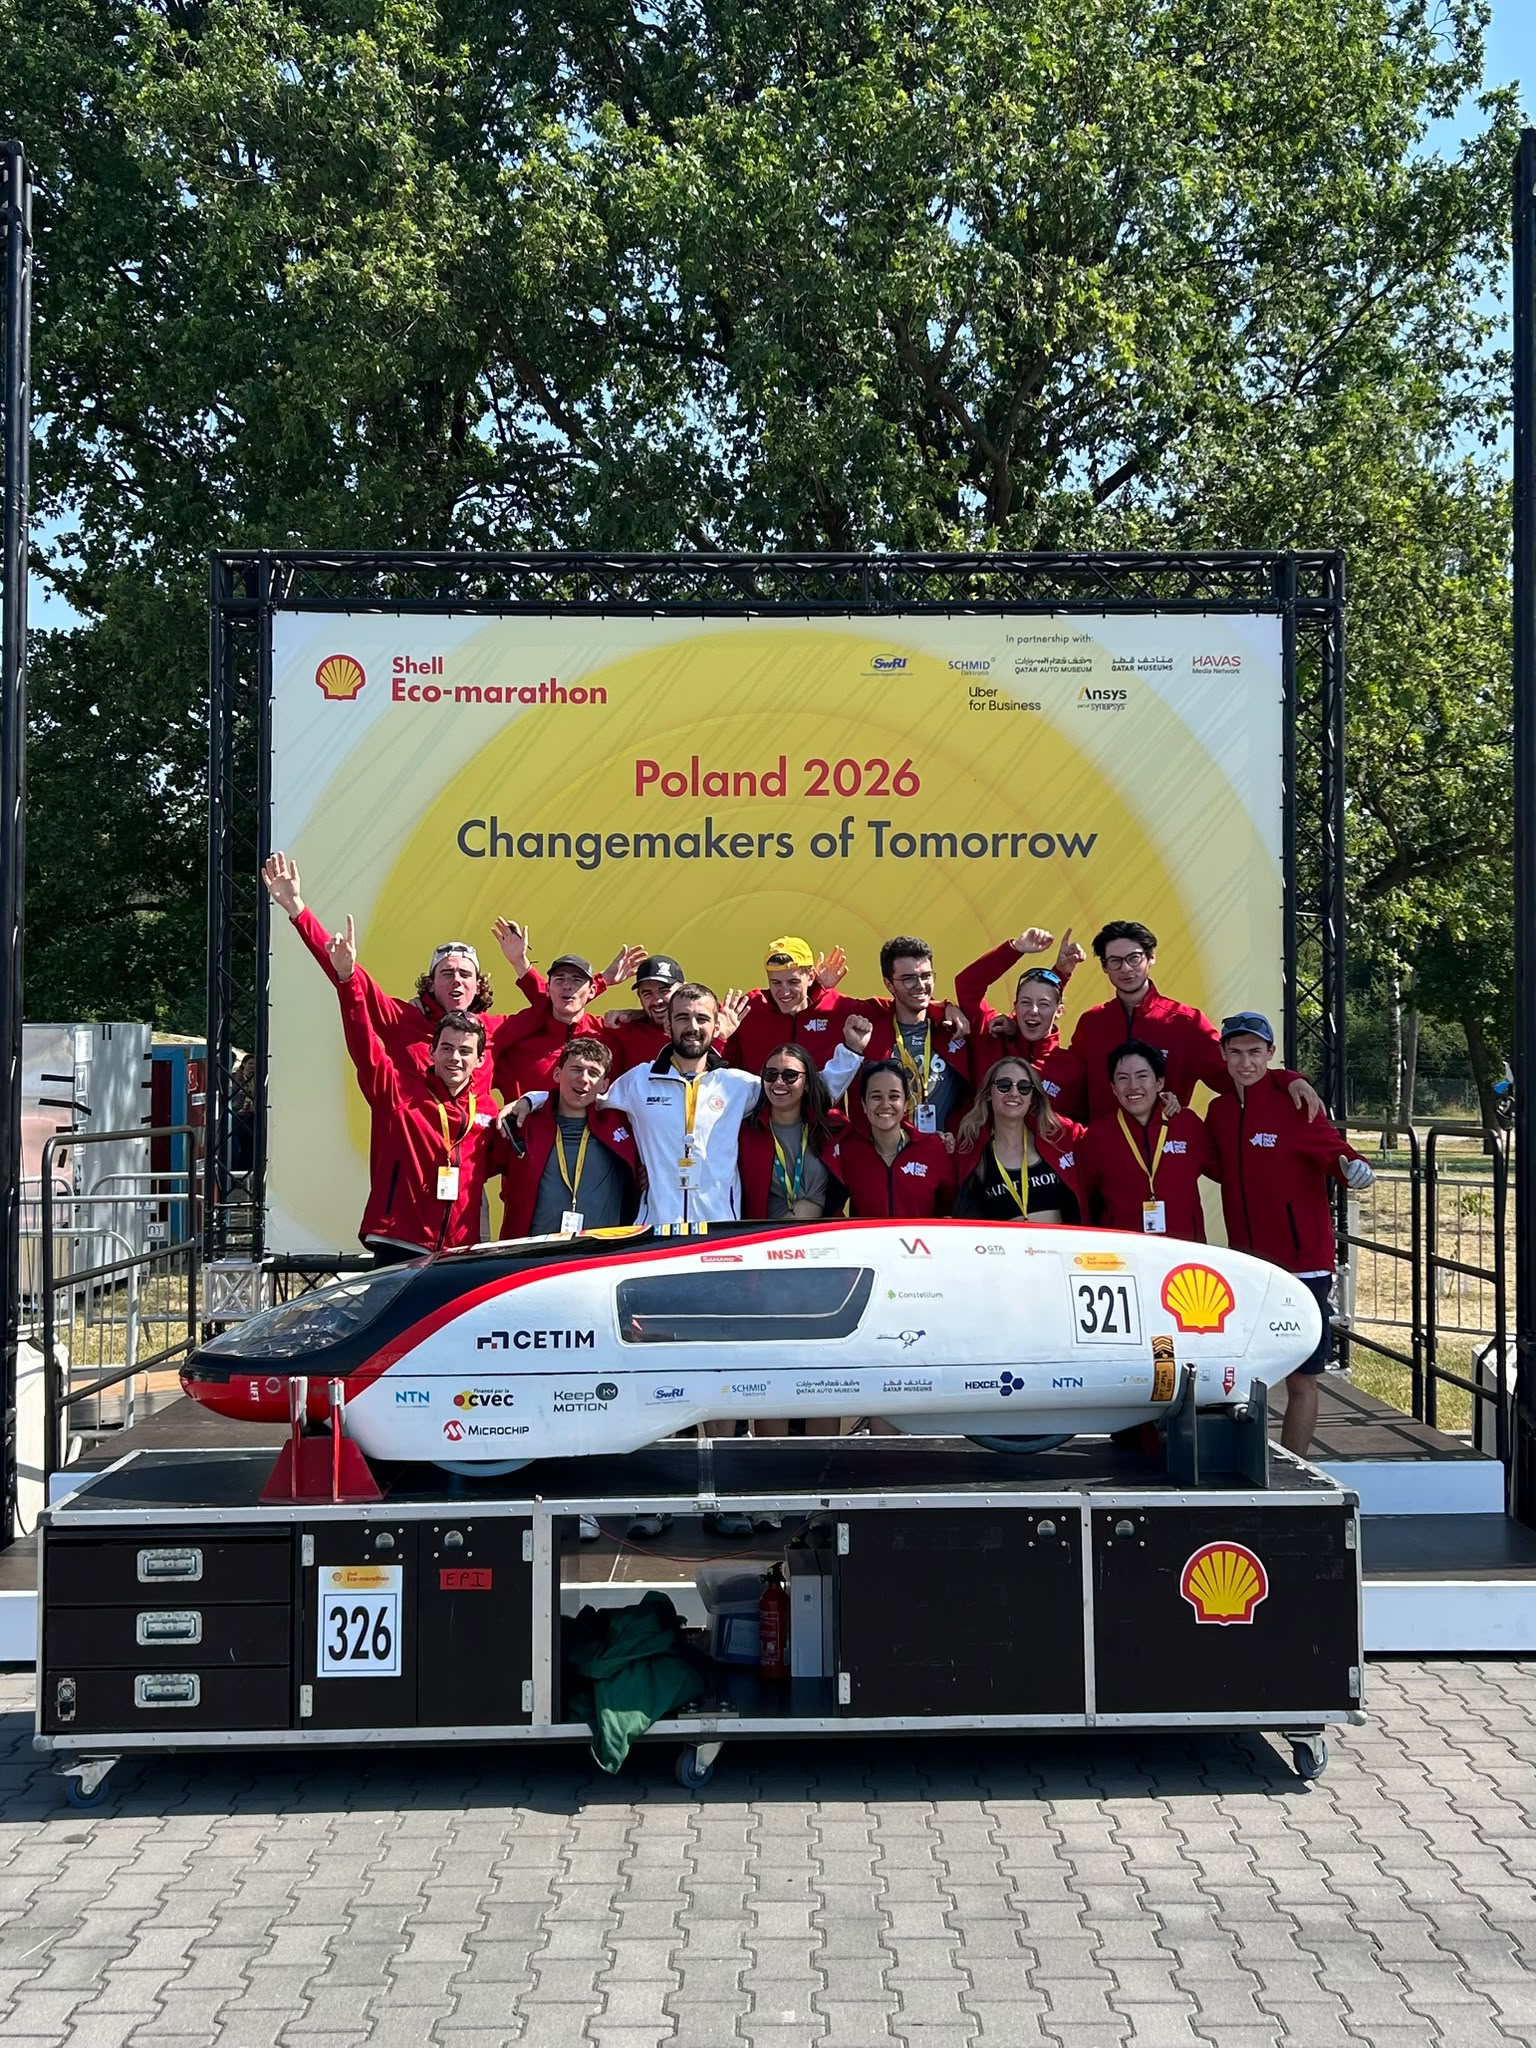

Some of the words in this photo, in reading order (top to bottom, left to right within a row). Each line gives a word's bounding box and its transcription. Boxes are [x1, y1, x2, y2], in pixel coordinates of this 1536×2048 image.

[1006, 634, 1014, 643] In
[1017, 633, 1070, 645] partnership
[1072, 634, 1094, 643] with:
[392, 656, 443, 675] Shell
[873, 658, 908, 669] SwRI
[948, 660, 991, 670] SCHMID
[1192, 655, 1241, 667] HAVAS
[1014, 666, 1038, 674] QATAR
[1137, 664, 1174, 672] MUSEUMS
[391, 678, 608, 705] Eco-marathon
[969, 687, 998, 697] Uber
[1077, 686, 1128, 700] Ansys
[969, 700, 986, 711] for
[989, 700, 1042, 711] Business
[635, 755, 787, 797] Poland
[803, 757, 922, 798] 2026
[457, 816, 797, 871] Changemakers
[810, 816, 856, 859] of
[867, 820, 1099, 859] Tomorrow
[767, 1249, 804, 1260] INSA
[898, 1291, 943, 1299] Constellium
[1078, 1284, 1132, 1334] 321
[513, 1330, 595, 1350] CETIM
[1052, 1377, 1084, 1389] NTN
[1226, 1367, 1234, 1388] LIFT
[732, 1383, 767, 1393] SCHMID
[965, 1380, 1001, 1390] HEXCEL
[250, 1381, 260, 1402] LIFT
[396, 1391, 430, 1403] NTN
[554, 1390, 595, 1402] Keep
[655, 1388, 684, 1399] SwRI
[468, 1394, 514, 1407] cvec
[553, 1402, 608, 1412] MOTION
[446, 1572, 485, 1588] EPI
[328, 1606, 392, 1661] 326
